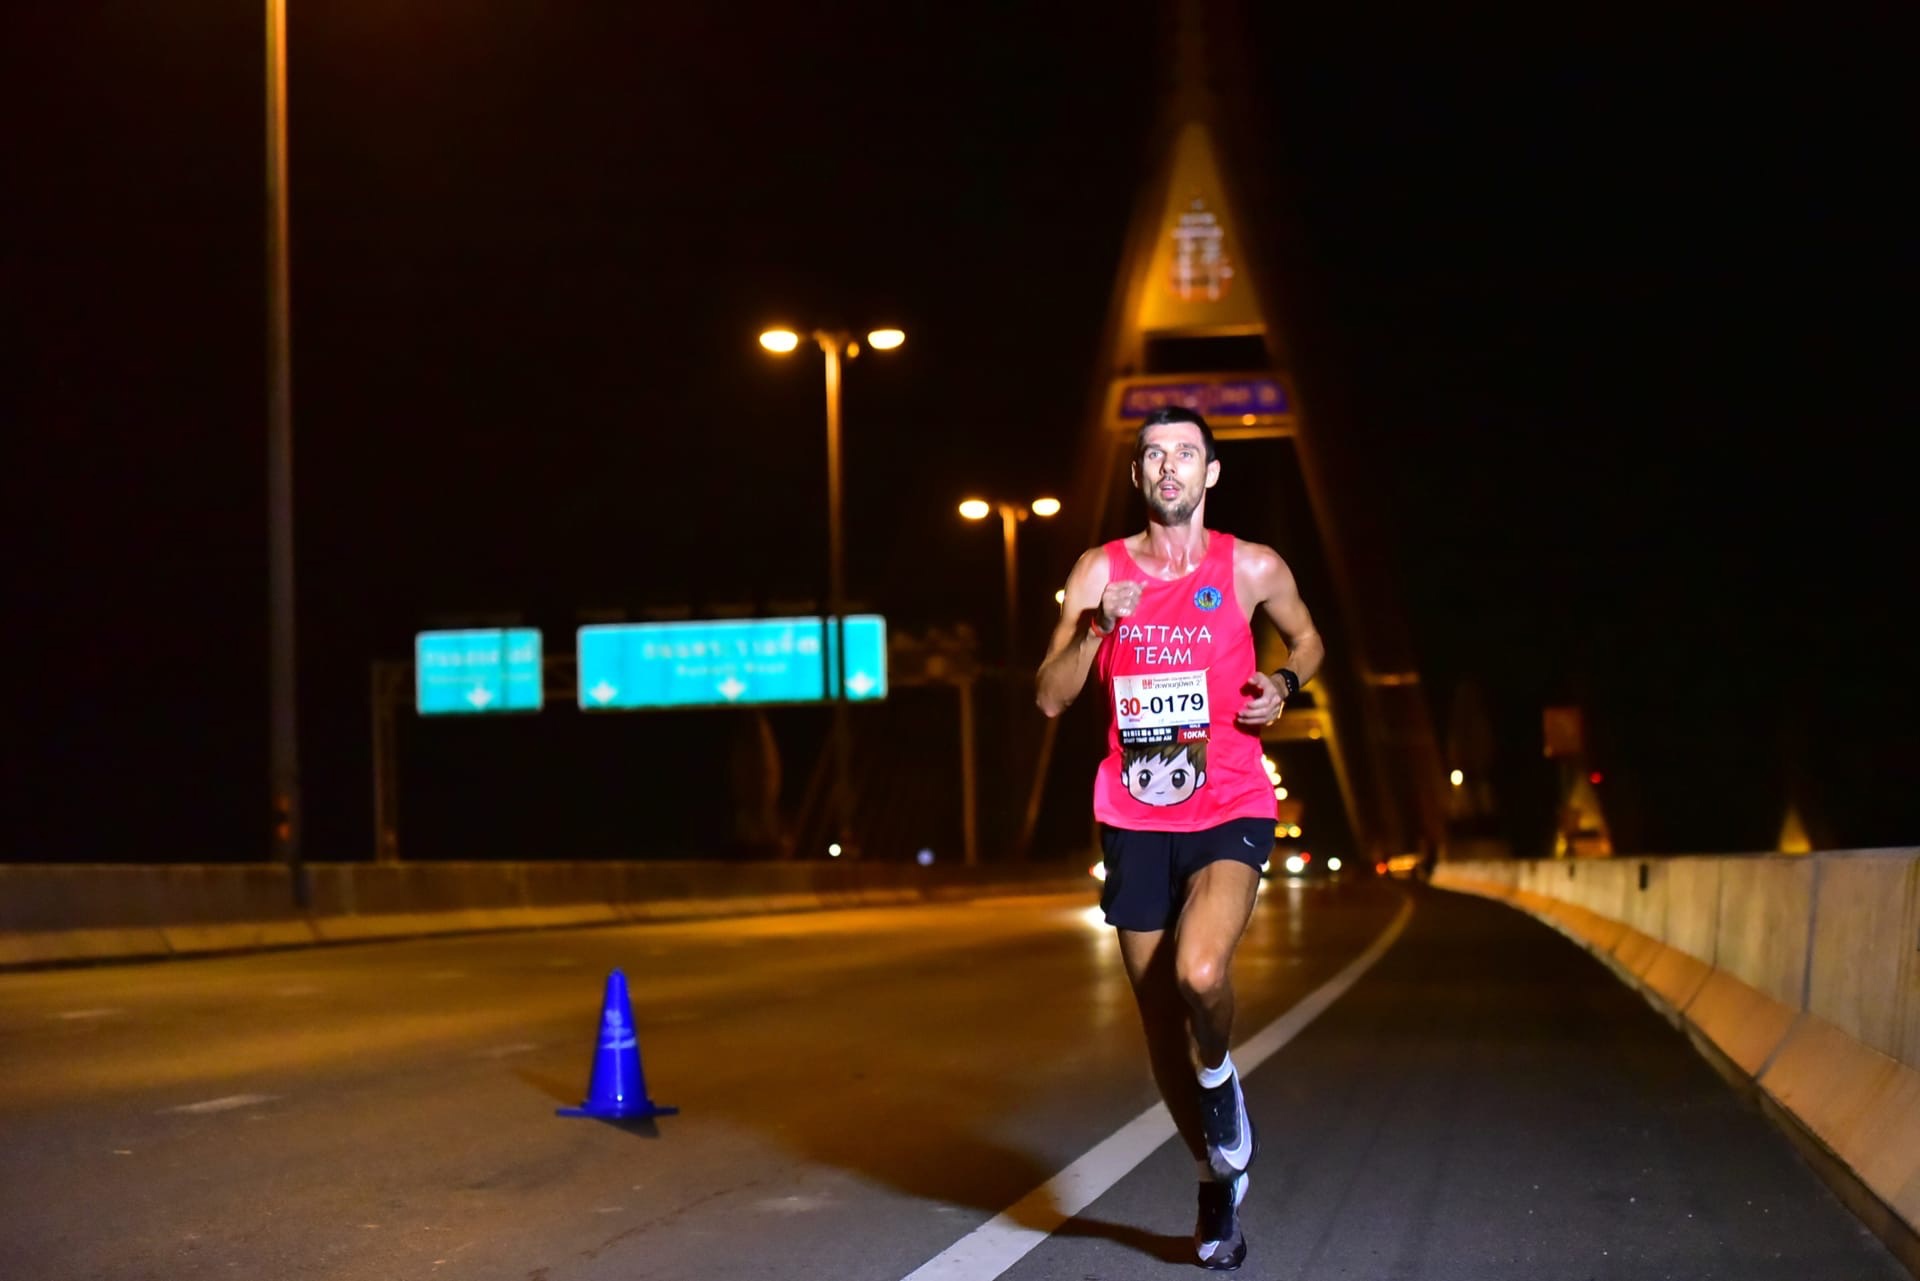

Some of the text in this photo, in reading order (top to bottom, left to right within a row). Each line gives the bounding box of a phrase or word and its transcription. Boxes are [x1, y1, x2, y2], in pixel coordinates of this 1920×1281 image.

[1119, 624, 1212, 644] PATTAYA
[1134, 646, 1192, 665] TEAM
[1119, 693, 1204, 717] 30-0179
